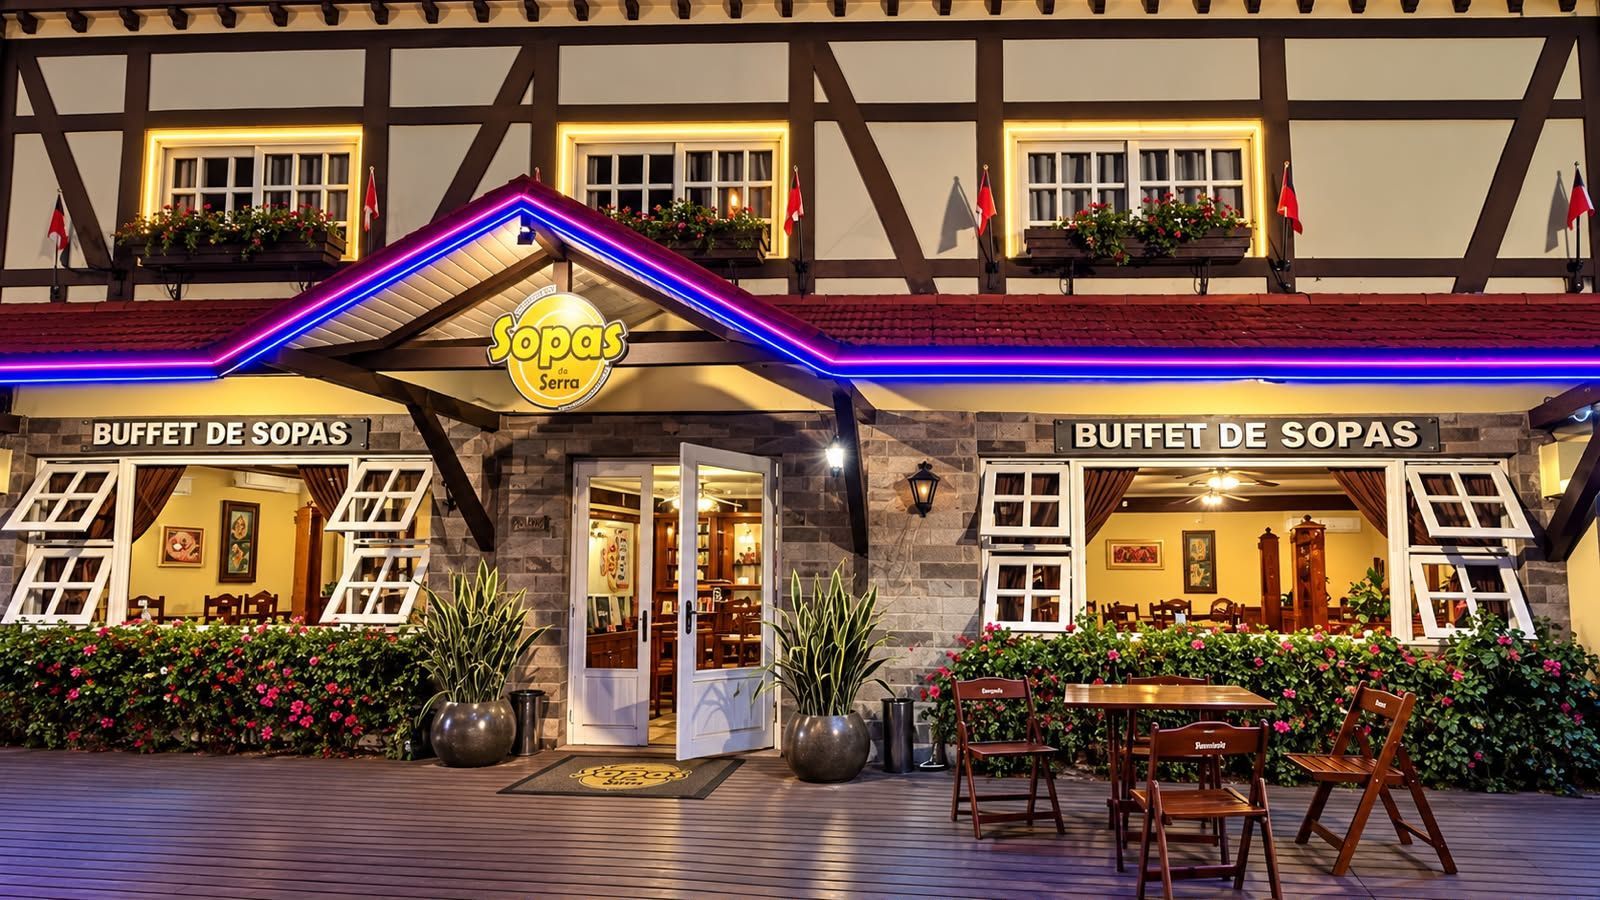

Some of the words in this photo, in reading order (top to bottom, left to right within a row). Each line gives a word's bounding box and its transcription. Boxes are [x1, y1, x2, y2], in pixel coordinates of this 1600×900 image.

[489, 314, 624, 370] Sopas
[540, 373, 580, 391] Serra
[558, 367, 568, 375] da
[93, 422, 199, 446] BUFFET
[206, 421, 245, 446] DE
[251, 421, 349, 446] SOPAS
[1074, 422, 1208, 449] BUFFET
[1218, 422, 1268, 448] DE
[1280, 420, 1419, 448] SOPAS
